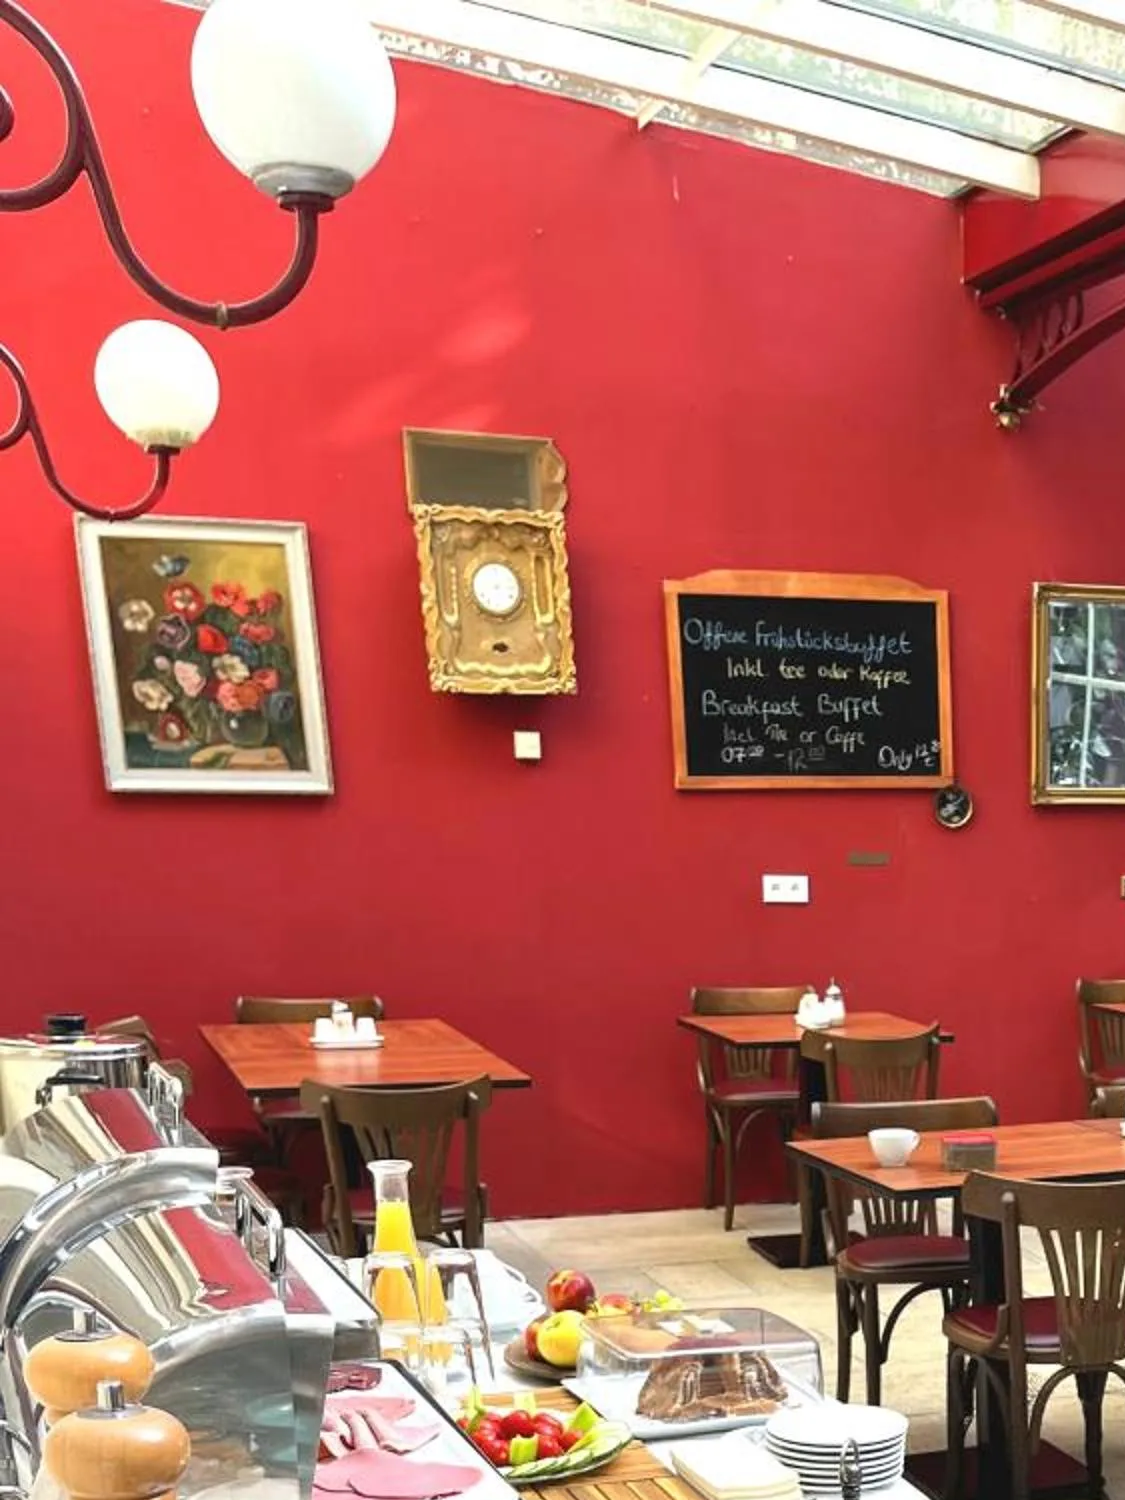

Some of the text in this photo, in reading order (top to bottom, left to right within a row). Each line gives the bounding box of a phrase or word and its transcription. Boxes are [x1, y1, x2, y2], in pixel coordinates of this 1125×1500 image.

[702, 689, 884, 725] Breakfast Buffet
[799, 731, 818, 743] or
